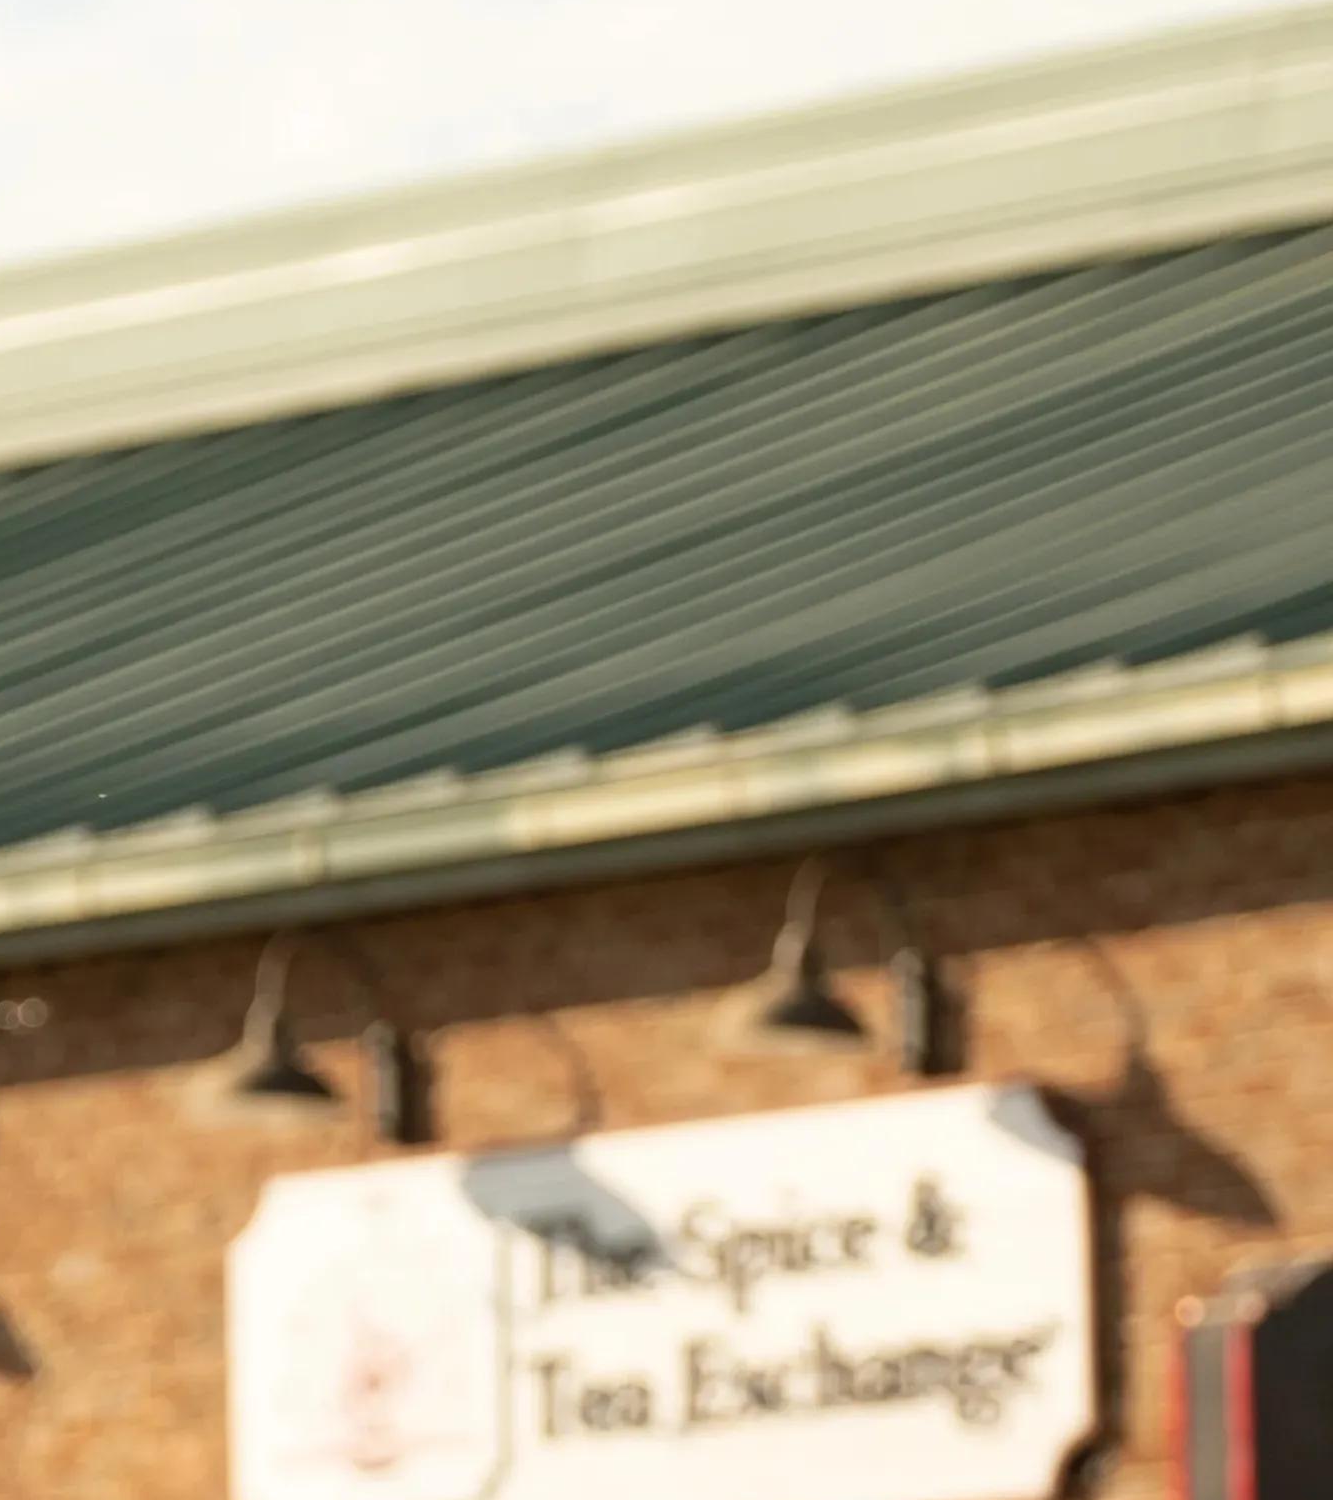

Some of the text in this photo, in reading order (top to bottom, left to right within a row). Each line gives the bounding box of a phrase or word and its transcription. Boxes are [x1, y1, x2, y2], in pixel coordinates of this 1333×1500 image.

[519, 1172, 965, 1314] The Spice &
[522, 1351, 653, 1441] Tea
